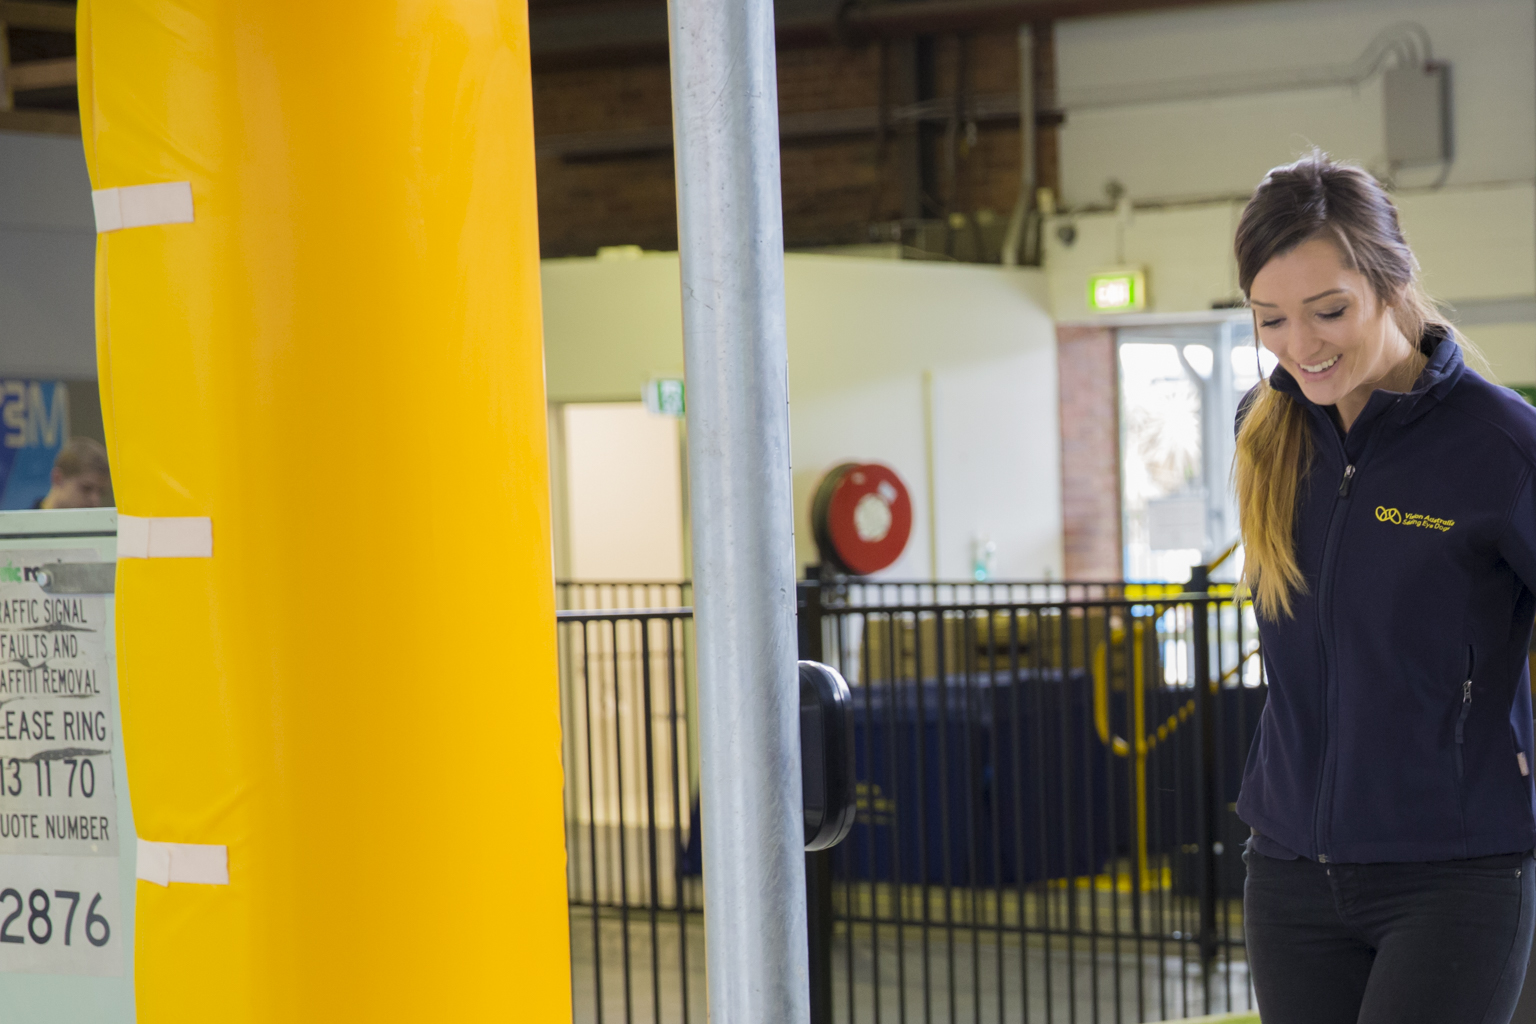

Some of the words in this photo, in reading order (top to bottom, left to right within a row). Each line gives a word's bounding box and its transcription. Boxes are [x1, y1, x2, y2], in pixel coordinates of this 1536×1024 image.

[0, 600, 38, 623] AFFIC
[44, 600, 87, 623] SIGNAL
[1, 635, 47, 658] FAULTS
[53, 635, 78, 658] AND
[43, 669, 100, 693] REMOVAL
[64, 711, 106, 741] RING
[64, 759, 95, 797] 70
[46, 815, 109, 840] NUMBER
[0, 888, 110, 947] 2876
